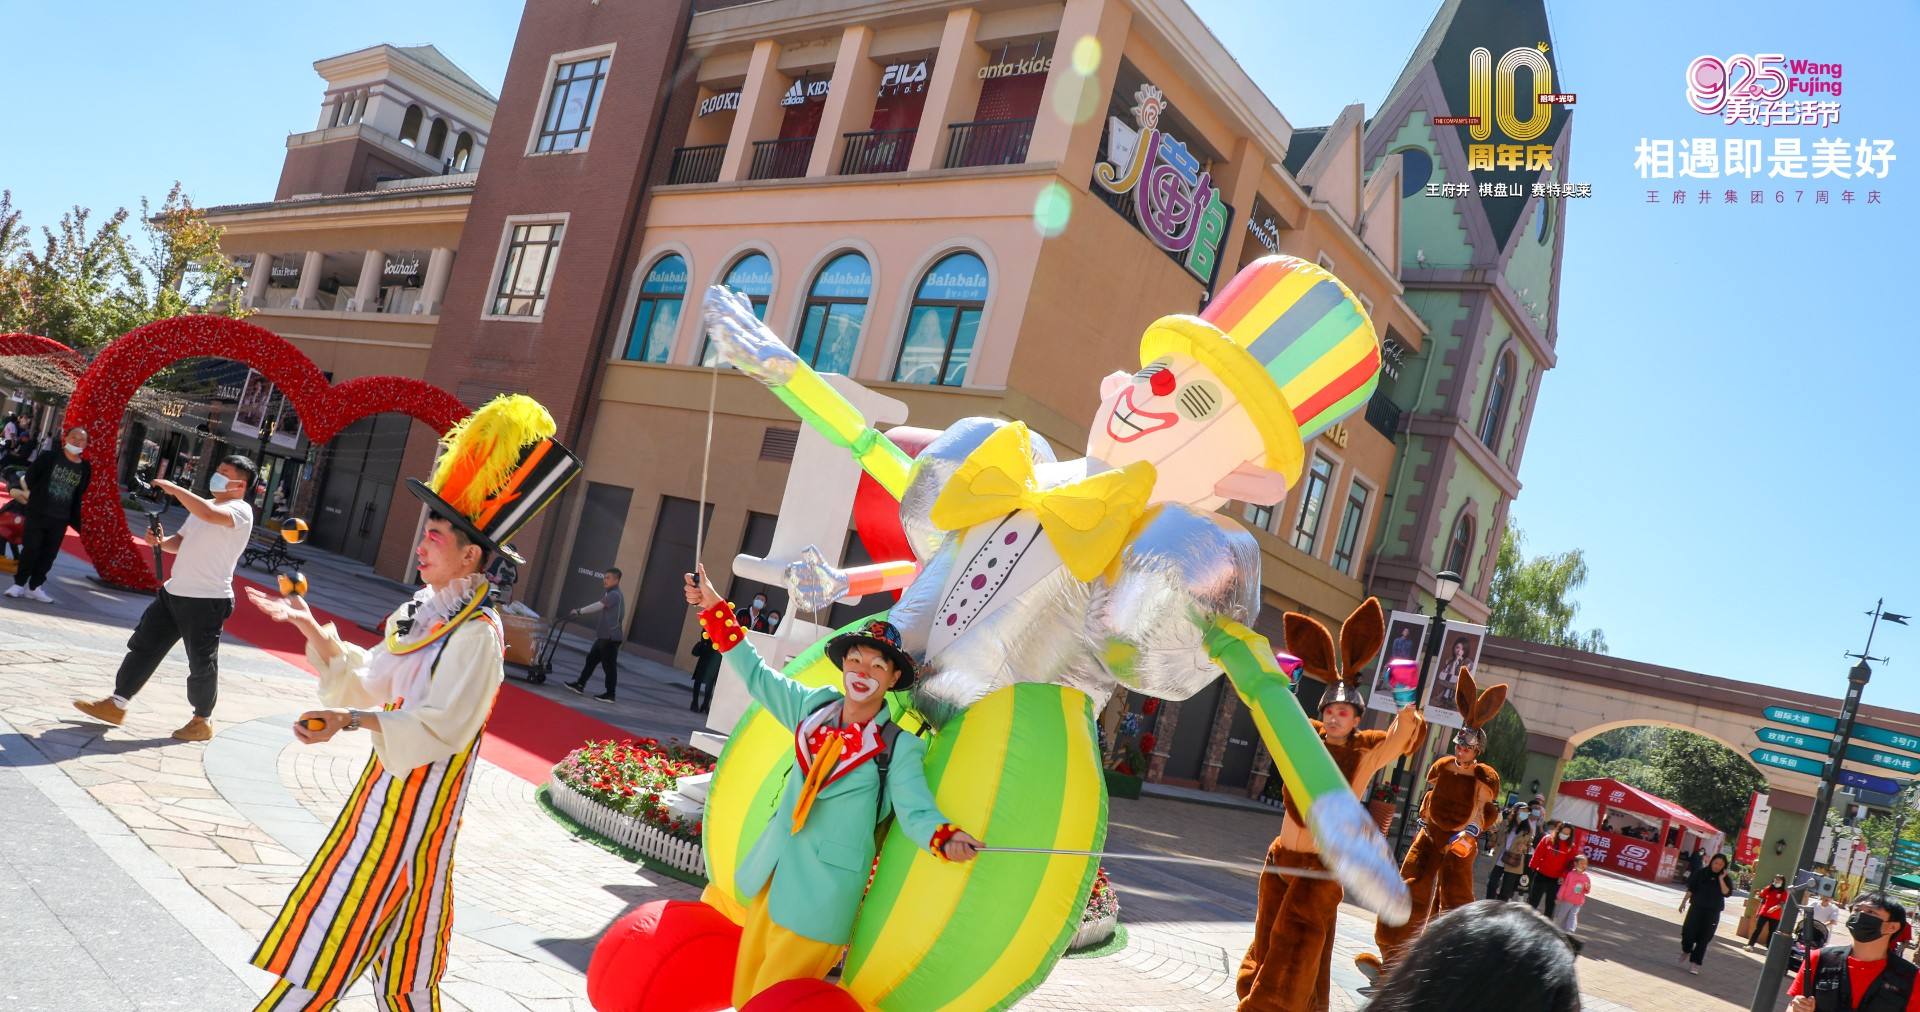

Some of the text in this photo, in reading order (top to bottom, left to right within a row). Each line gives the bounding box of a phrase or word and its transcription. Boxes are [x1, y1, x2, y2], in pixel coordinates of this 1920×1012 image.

[882, 60, 928, 87] FILA
[977, 62, 1014, 79] anta
[699, 92, 743, 117] ROOKI
[780, 95, 805, 106] adidas
[927, 272, 987, 288] Balabala
[161, 403, 185, 418] ALLY
[1890, 735, 1918, 750] 3号门
[1760, 752, 1798, 768] 儿童乐园
[1587, 834, 1612, 849] 商品
